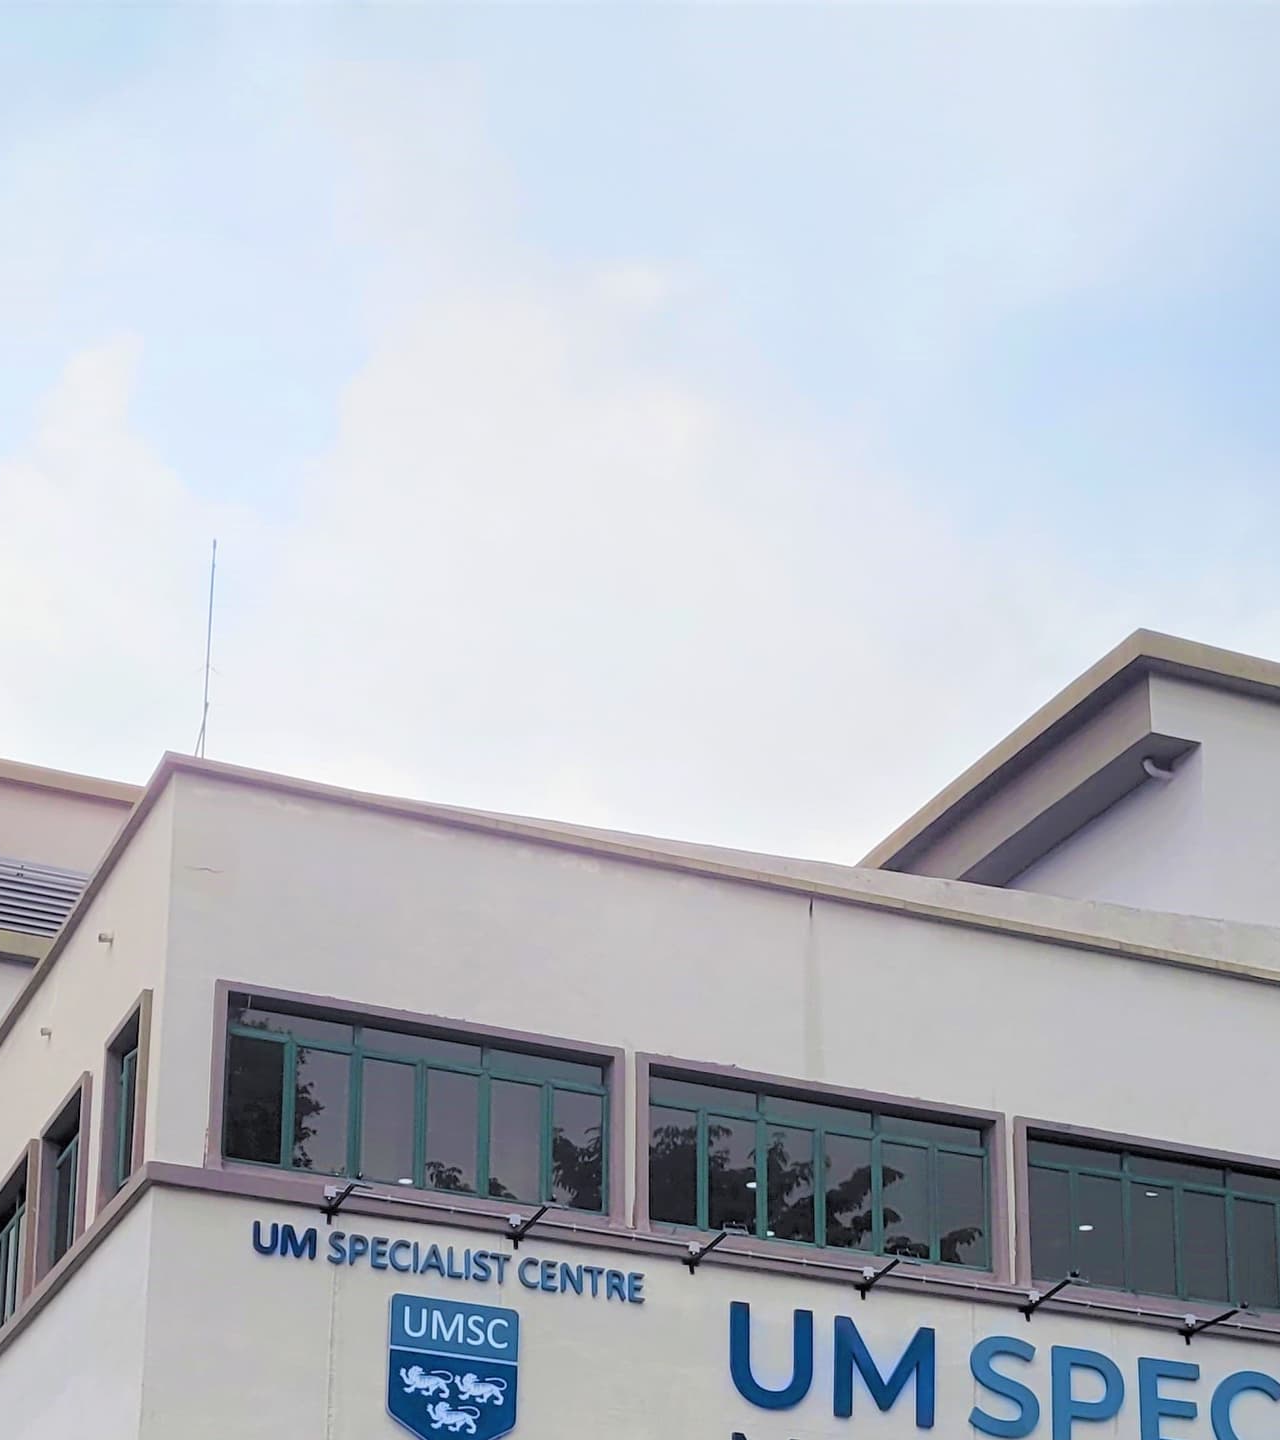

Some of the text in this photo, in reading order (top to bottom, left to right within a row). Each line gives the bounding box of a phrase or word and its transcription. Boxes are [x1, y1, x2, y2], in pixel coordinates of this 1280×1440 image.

[252, 1220, 646, 1304] UM SPECIALIST CENTRE
[403, 1305, 509, 1350] UMSC
[729, 1301, 936, 1429] UM
